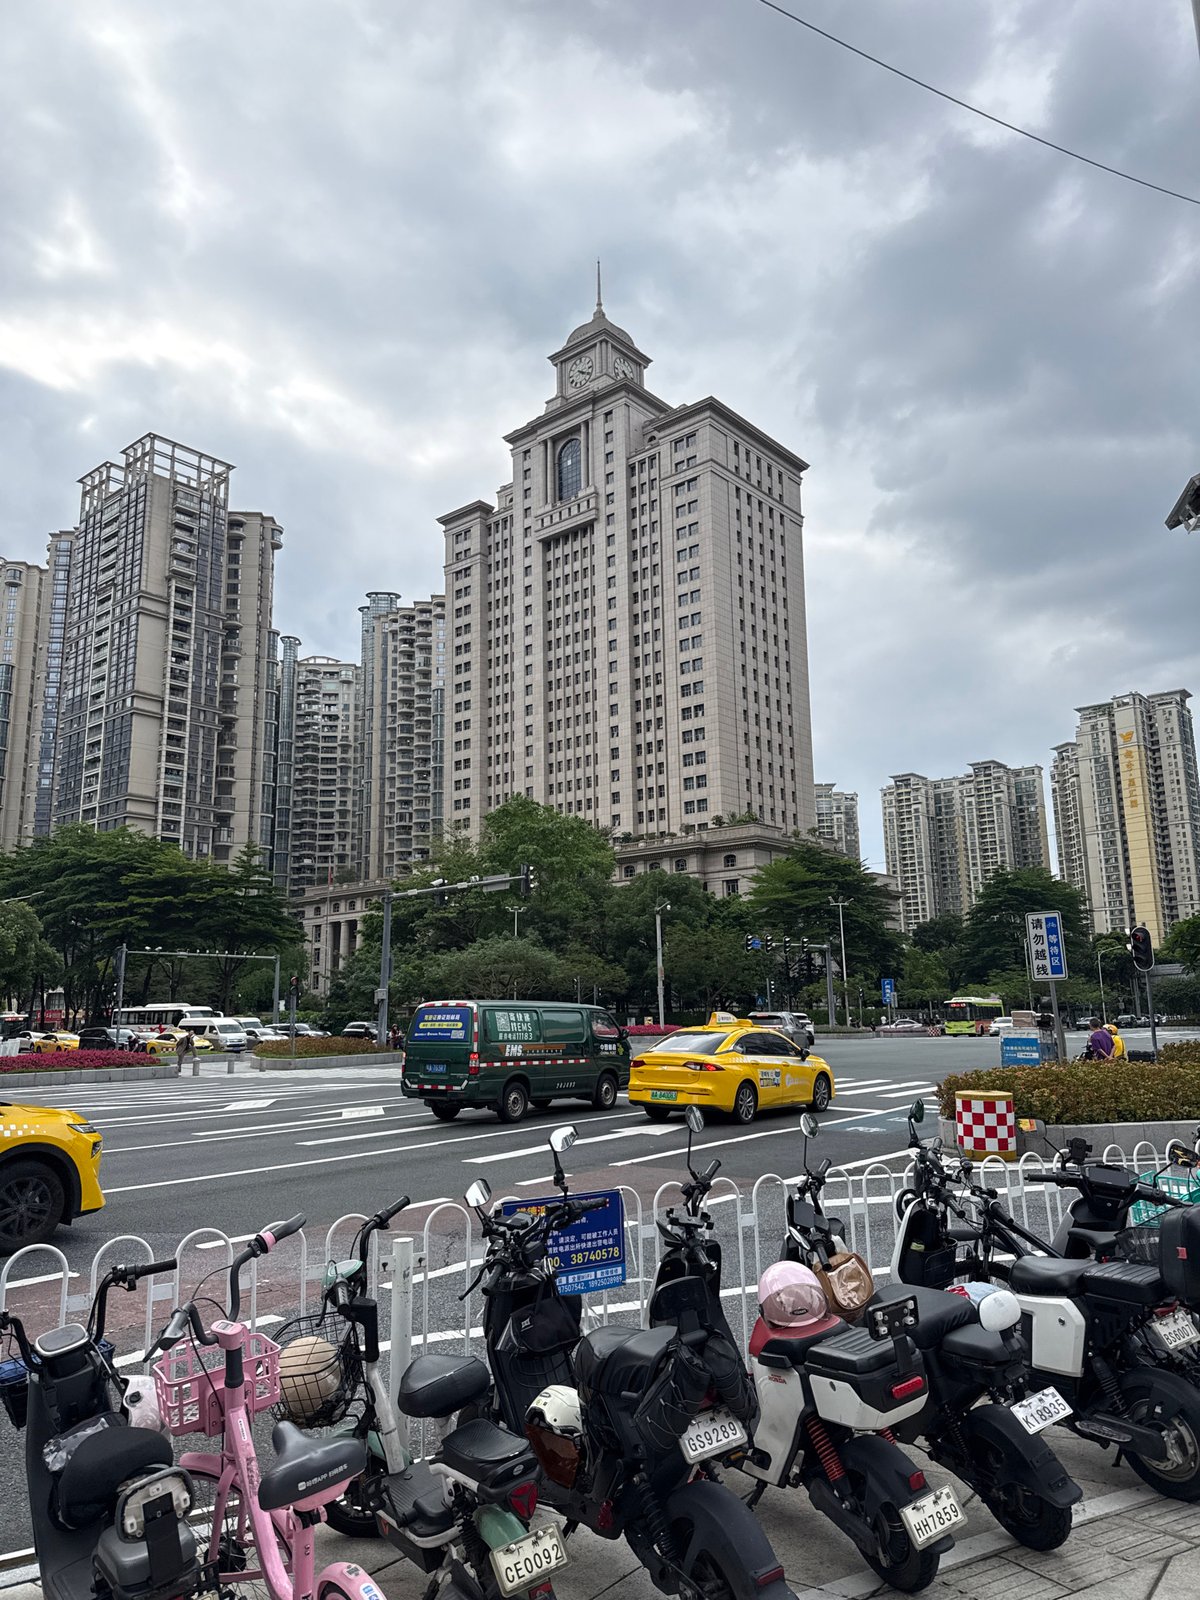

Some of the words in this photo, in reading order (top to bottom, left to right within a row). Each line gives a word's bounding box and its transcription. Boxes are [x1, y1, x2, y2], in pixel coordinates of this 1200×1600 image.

[1031, 918, 1048, 976] 请勿越线
[1048, 934, 1060, 966] 等待区
[504, 1044, 523, 1057] EMS
[1163, 1324, 1194, 1345] BS6007
[1022, 1399, 1067, 1429] K18935
[688, 1421, 738, 1452] GS9289
[913, 1503, 959, 1539] HH7859
[505, 1543, 562, 1584] CE0092
